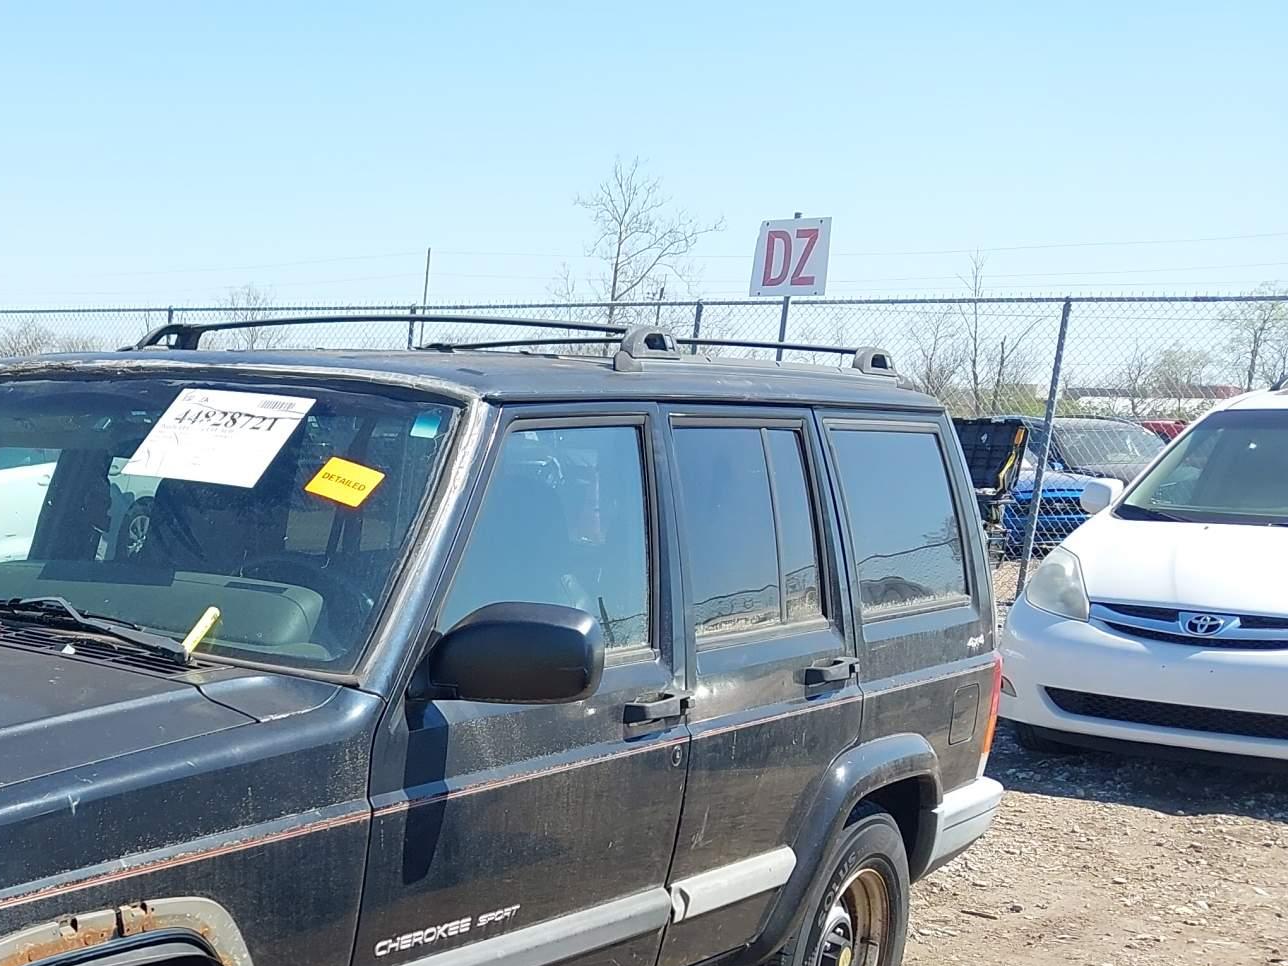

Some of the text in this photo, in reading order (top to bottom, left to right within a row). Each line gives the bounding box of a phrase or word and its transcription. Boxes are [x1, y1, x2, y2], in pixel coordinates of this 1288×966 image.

[762, 228, 819, 286] DZ
[174, 408, 279, 432] 44828721
[321, 471, 366, 492] DETAILED
[374, 904, 521, 956] CHEROKEE SPORT
